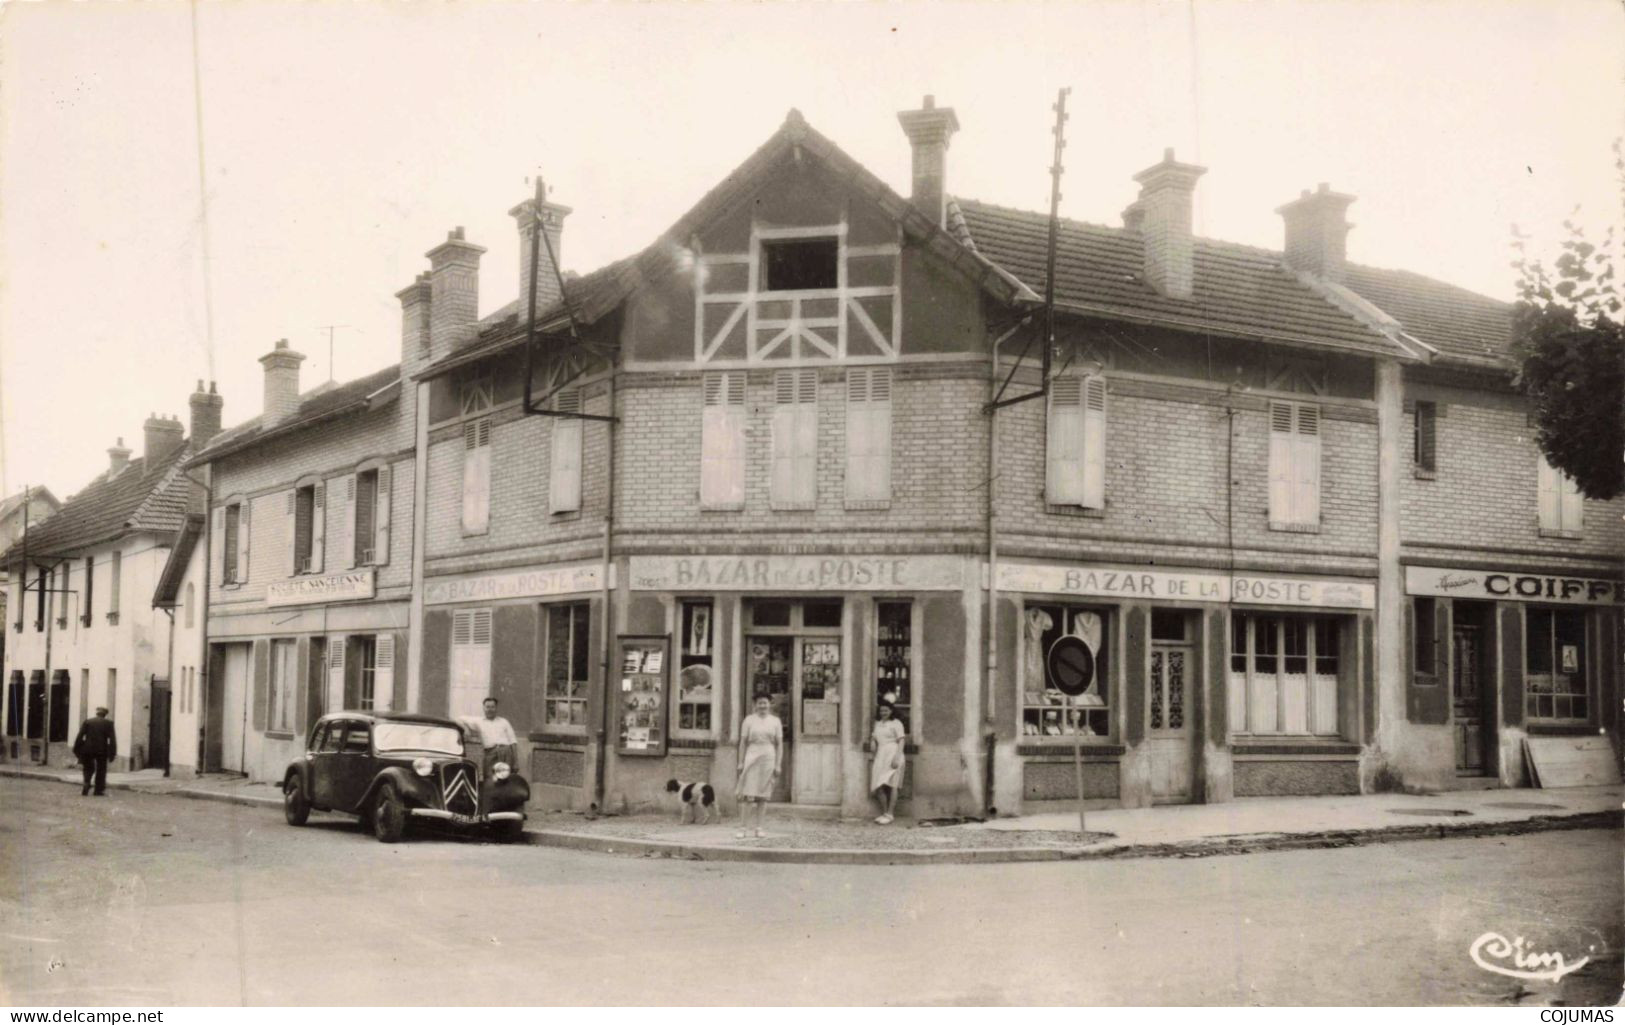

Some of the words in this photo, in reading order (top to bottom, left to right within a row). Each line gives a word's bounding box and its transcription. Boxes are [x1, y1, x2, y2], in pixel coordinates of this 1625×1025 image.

[448, 578, 497, 599] BAZAR
[517, 571, 567, 595] POSTE
[676, 559, 769, 586] BAZAR
[799, 569, 815, 585] LA
[819, 559, 909, 586] POSTE
[1062, 569, 1155, 595] BAZAR
[1168, 579, 1189, 595] DE
[1200, 581, 1219, 597] LA
[1234, 578, 1312, 602] POSTE
